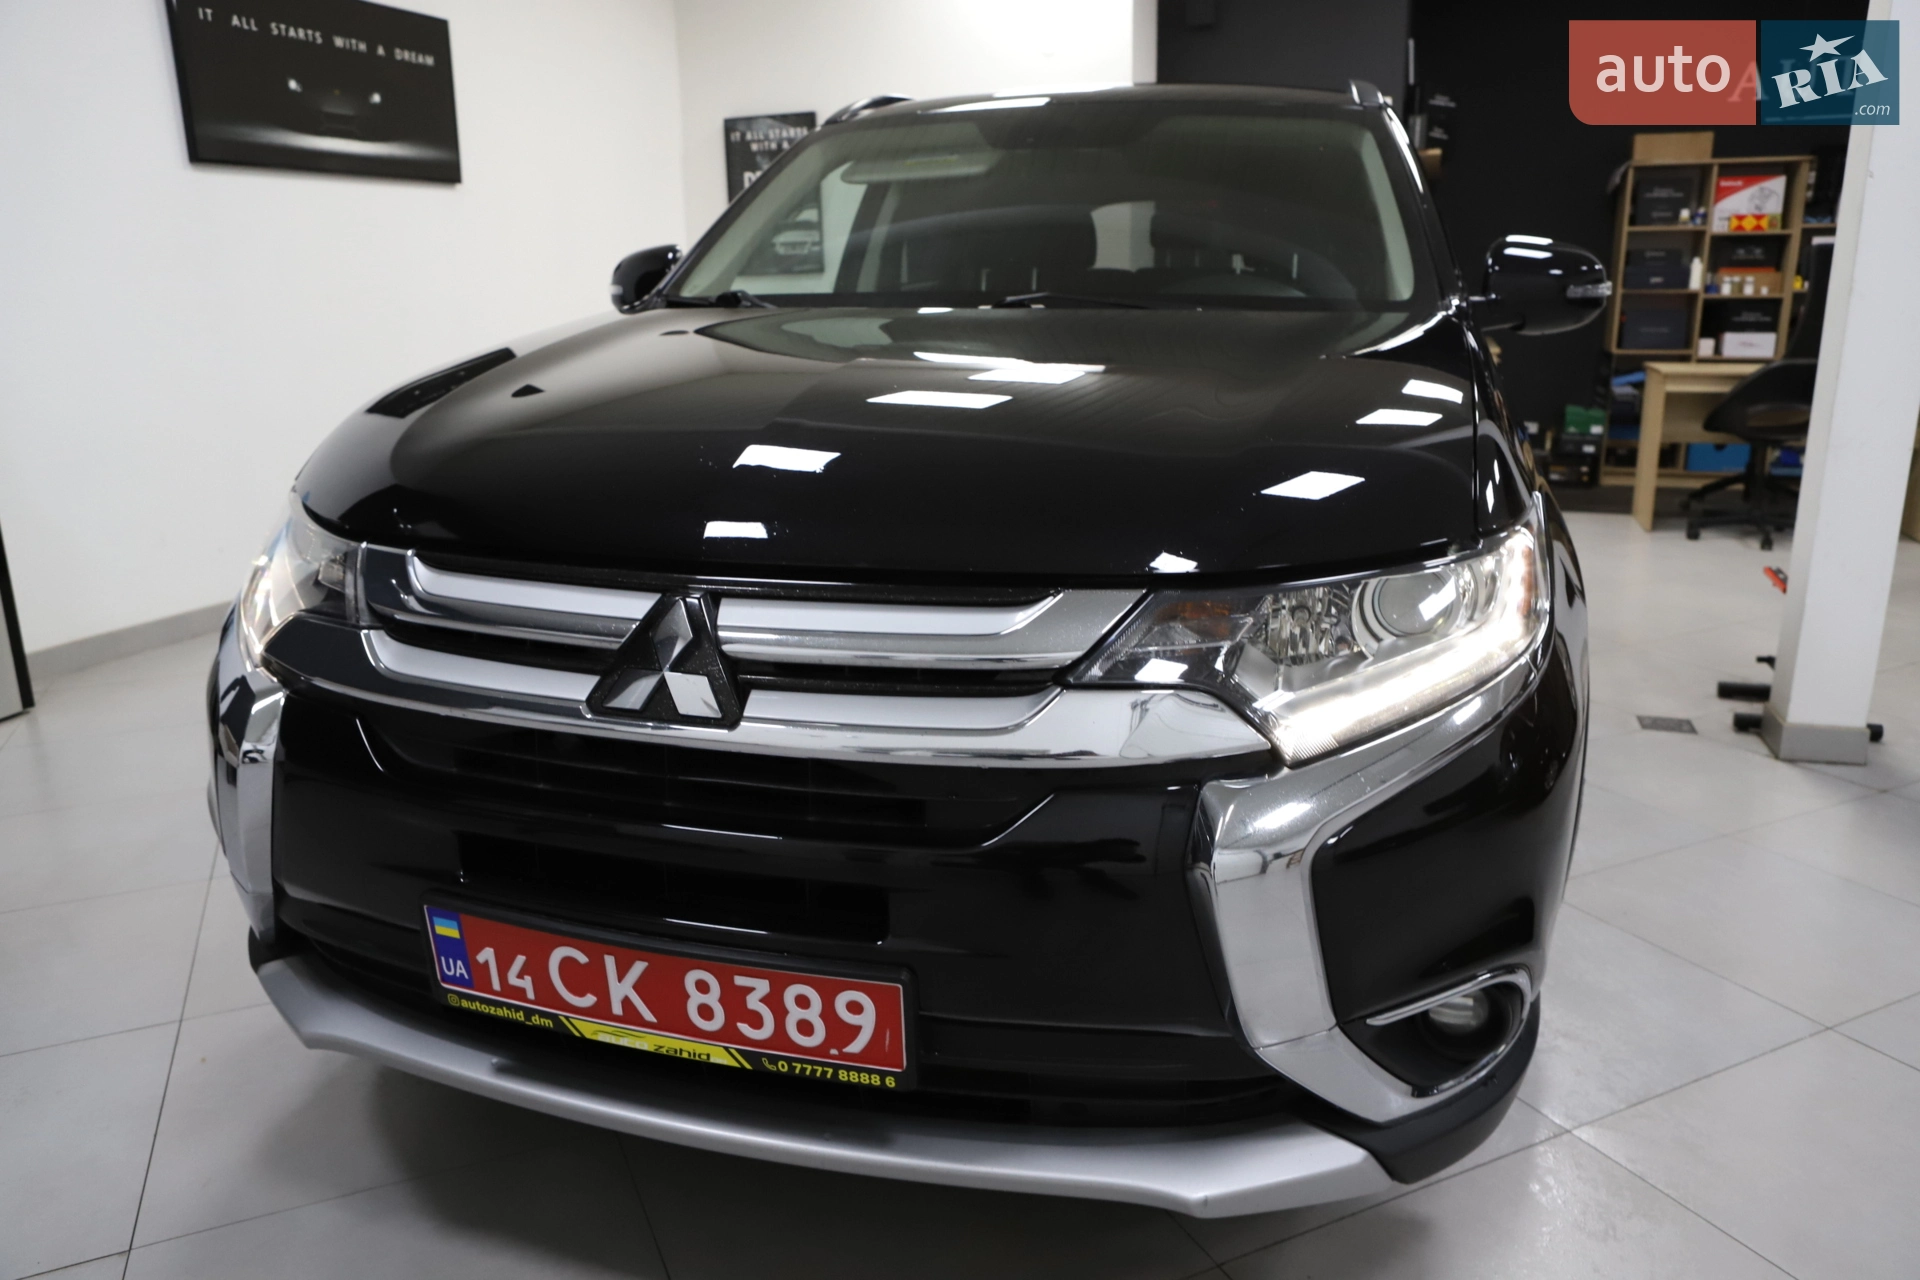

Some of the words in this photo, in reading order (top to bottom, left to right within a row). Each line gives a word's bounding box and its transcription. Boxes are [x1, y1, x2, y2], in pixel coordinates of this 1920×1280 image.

[197, 6, 213, 22] IT
[231, 14, 258, 31] ALL
[269, 21, 323, 44] STARTS
[332, 34, 367, 53] WITH
[376, 44, 386, 57] A
[393, 46, 435, 67] DREAM
[730, 131, 741, 142] IT
[746, 130, 765, 141] ALL
[750, 141, 777, 152] WITH
[441, 956, 469, 980] UA
[476, 947, 536, 1000] 14
[548, 945, 659, 1024] CK
[684, 969, 877, 1055] 8389
[653, 1043, 711, 1062] zahid
[777, 1060, 789, 1073] 0
[791, 1062, 834, 1079] 7777
[838, 1069, 881, 1086] 8888
[885, 1076, 896, 1088] 6
